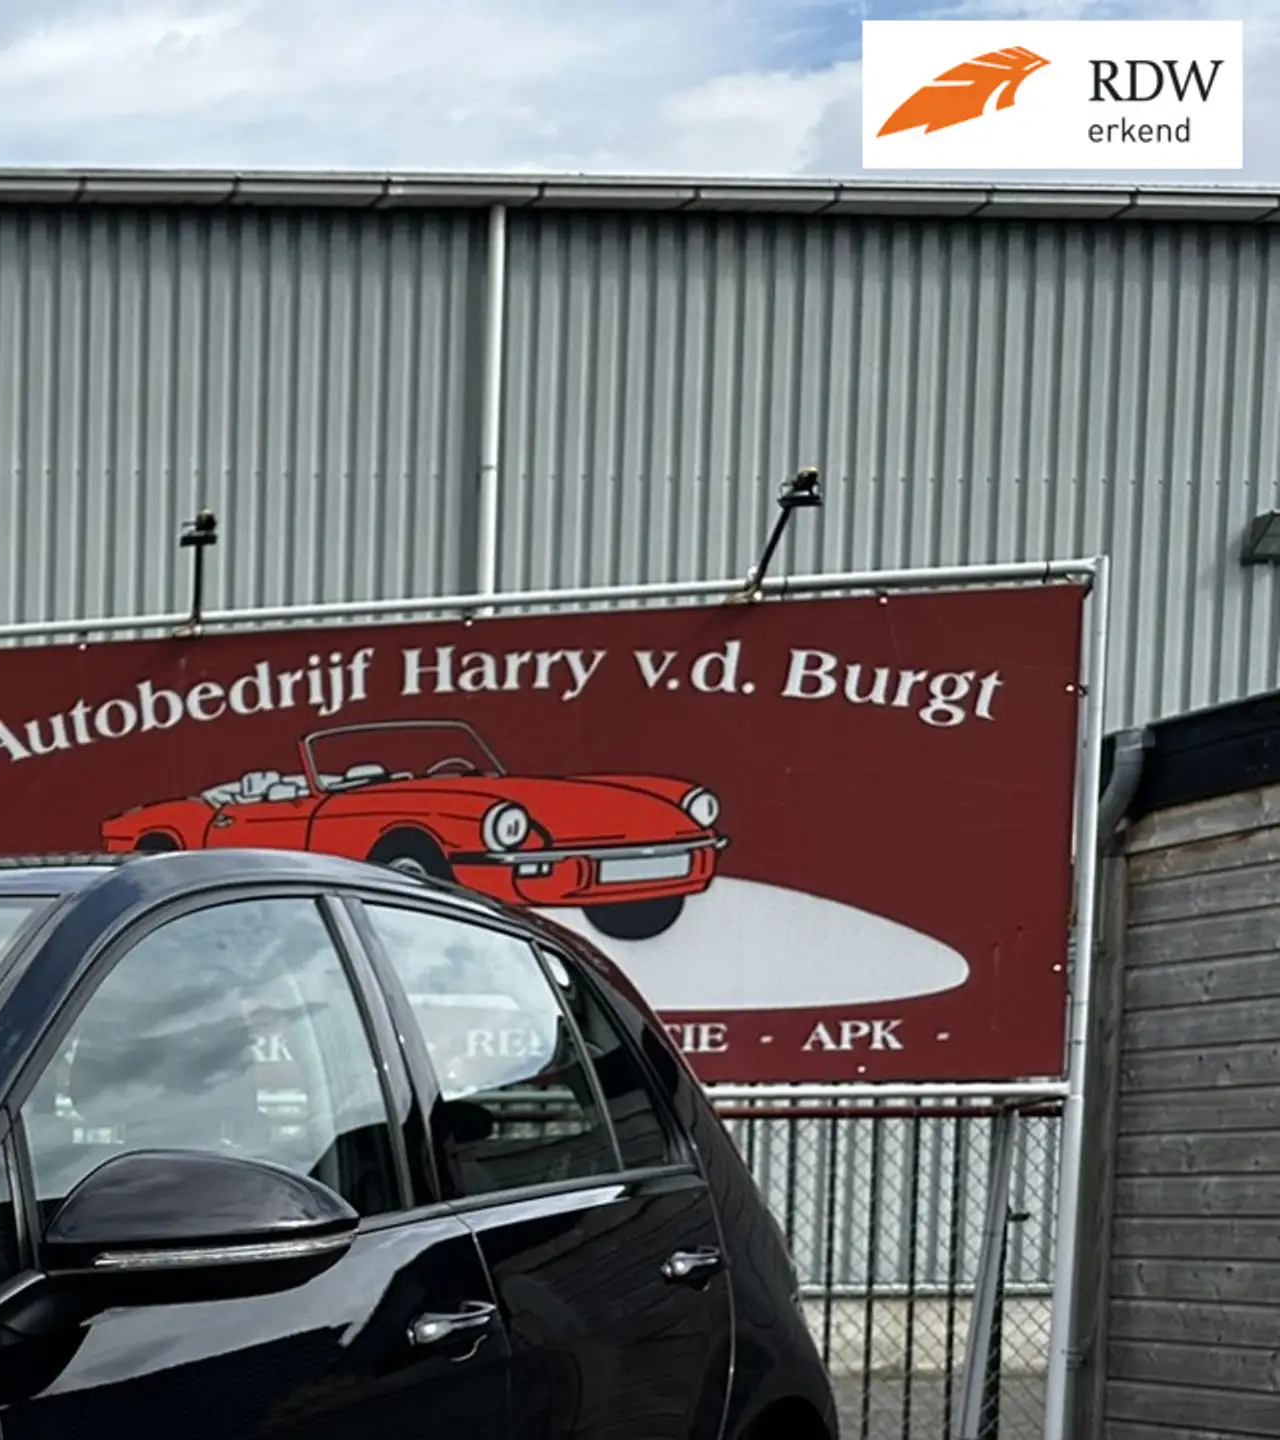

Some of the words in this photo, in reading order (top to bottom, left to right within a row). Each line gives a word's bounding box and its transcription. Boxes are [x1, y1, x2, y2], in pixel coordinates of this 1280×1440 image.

[401, 645, 607, 701] Harry
[634, 640, 757, 695] v.d.
[780, 648, 1004, 727] Burgt
[801, 1019, 903, 1052] APK
